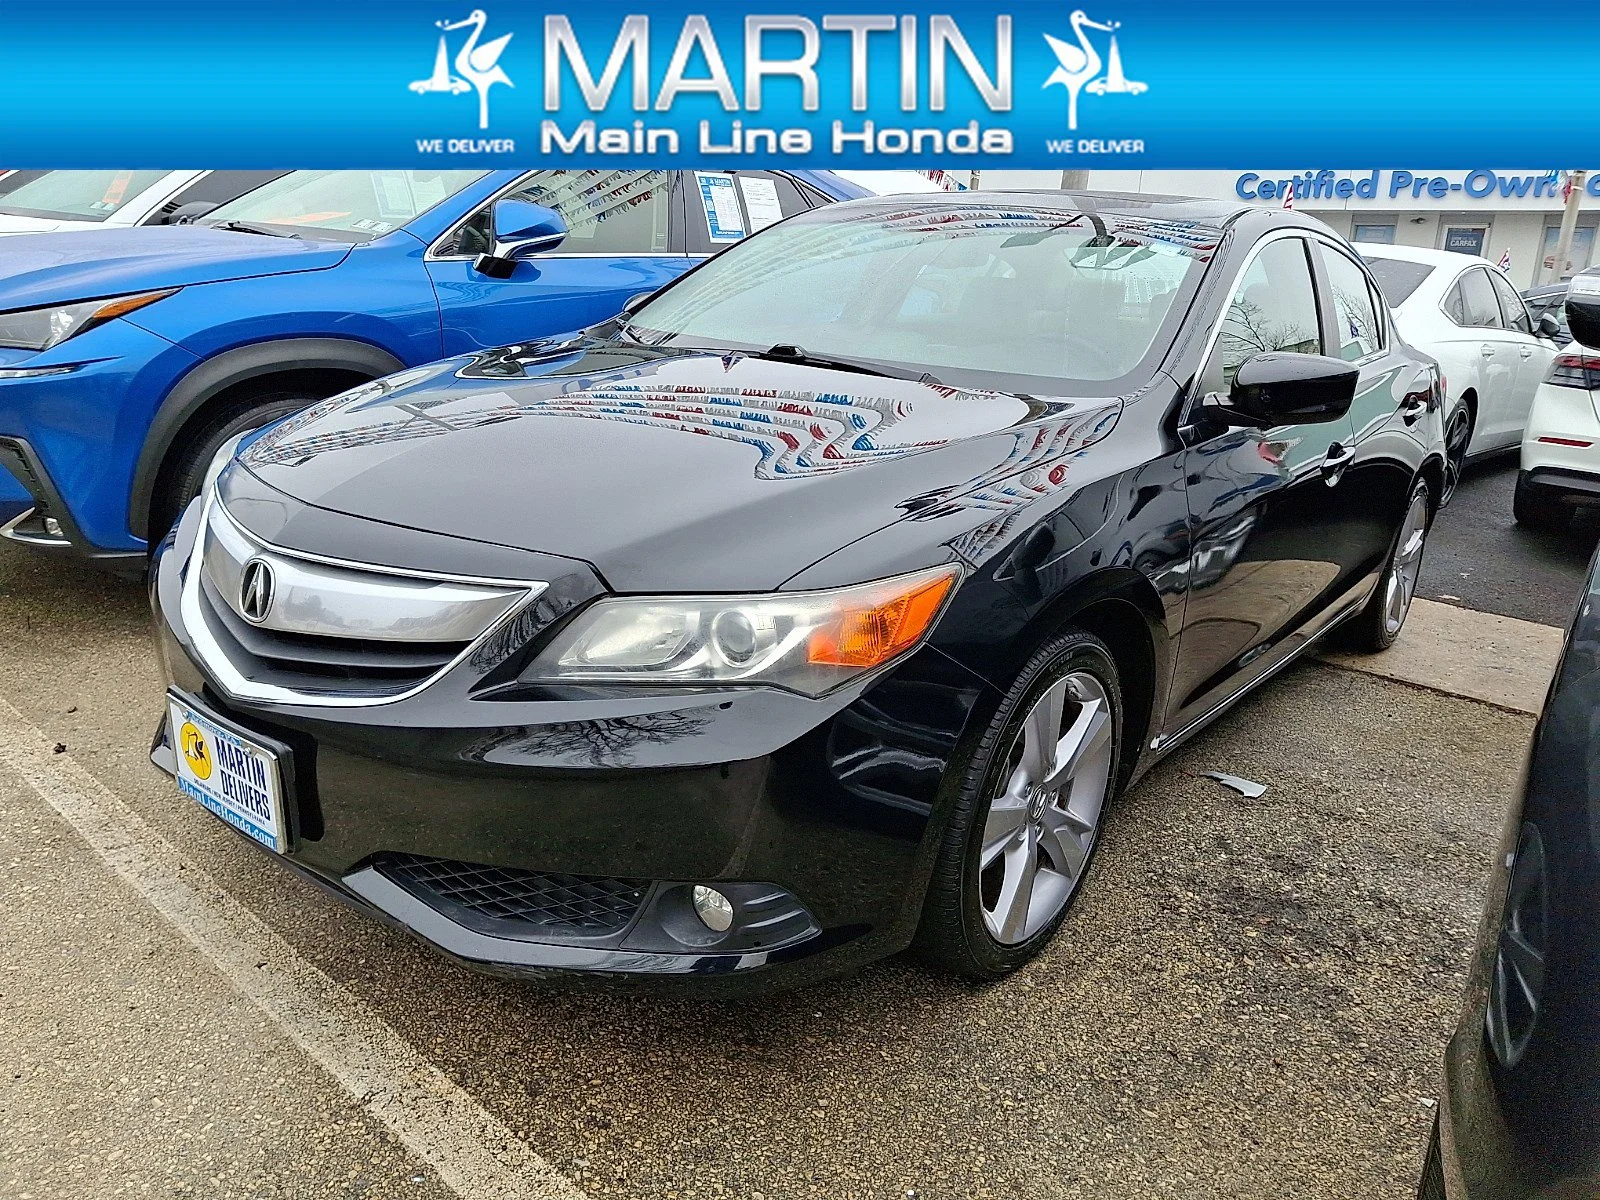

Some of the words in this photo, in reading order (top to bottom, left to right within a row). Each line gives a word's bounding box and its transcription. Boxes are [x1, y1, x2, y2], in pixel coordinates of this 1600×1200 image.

[1235, 169, 1380, 200] Certified
[214, 736, 267, 792] MARTIN
[220, 769, 271, 822] DELIVERS
